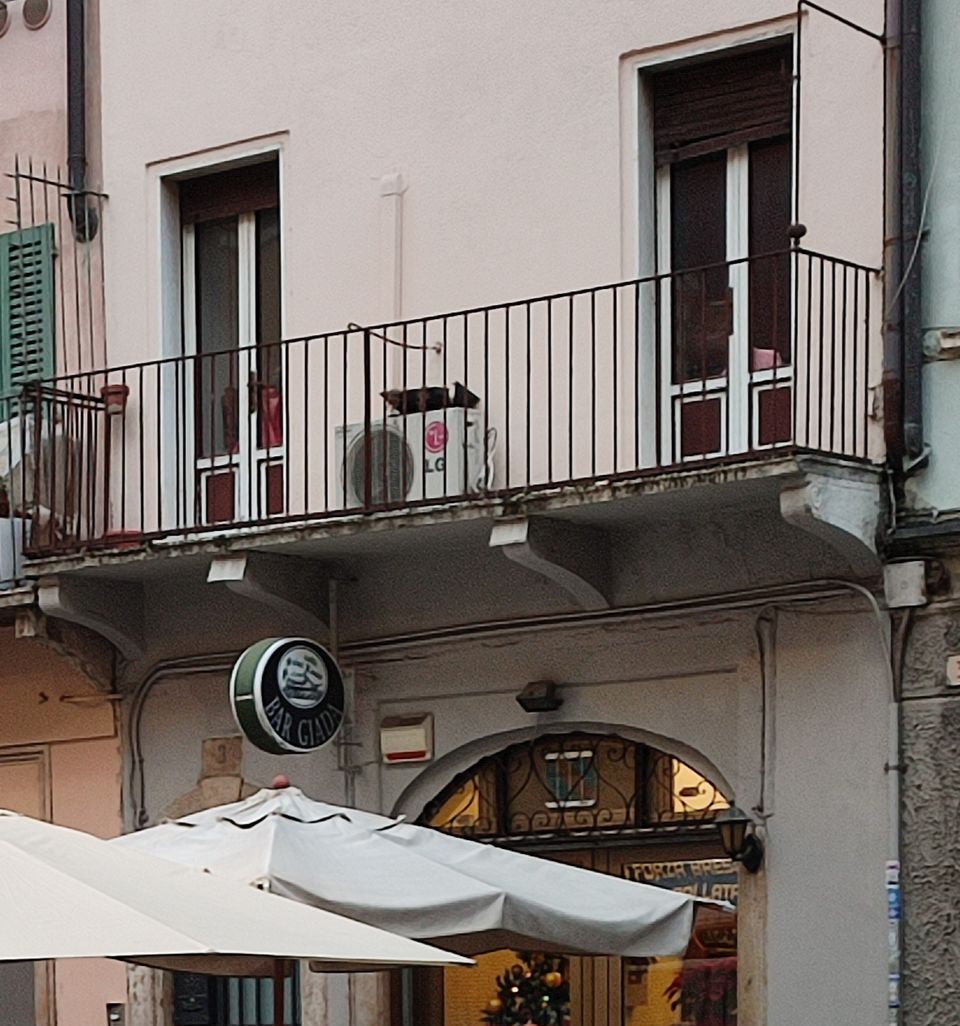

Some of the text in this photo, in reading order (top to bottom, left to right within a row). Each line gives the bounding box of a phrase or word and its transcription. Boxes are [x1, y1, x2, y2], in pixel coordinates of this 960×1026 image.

[424, 457, 445, 473] LG
[265, 696, 344, 747] BAR GIADA
